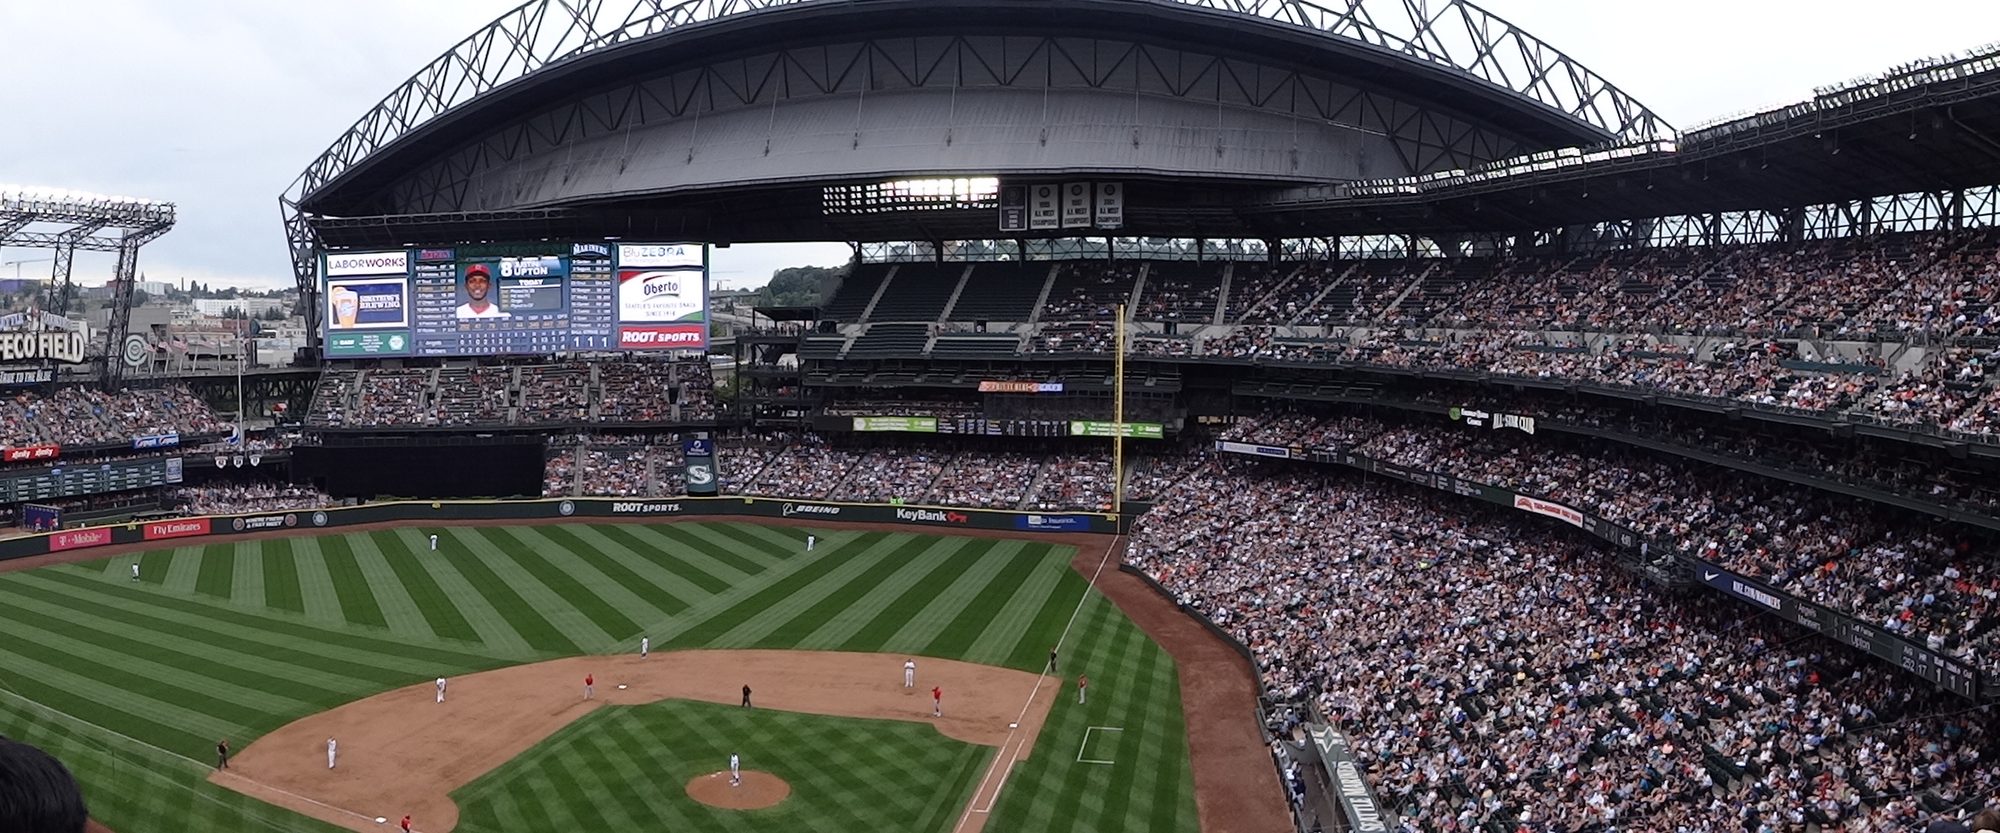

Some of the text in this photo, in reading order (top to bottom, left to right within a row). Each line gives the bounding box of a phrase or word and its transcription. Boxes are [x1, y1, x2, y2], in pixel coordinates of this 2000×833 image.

[573, 243, 608, 256] MARINERS
[501, 261, 513, 277] 8
[514, 266, 548, 276] UPTON
[643, 281, 678, 295] Oberto
[574, 336, 607, 348] 1 1 1
[621, 331, 700, 343] ROOT SPORTS
[38, 331, 85, 363] FIELD
[36, 368, 52, 382] BLUE
[1519, 416, 1535, 435] CLUB
[613, 502, 680, 512] ROOT SPORTS
[796, 505, 841, 515] BOEING
[896, 508, 947, 522] KeyBank
[153, 522, 201, 535] Fly Emirates
[1851, 634, 1871, 651] Upton
[1918, 664, 1927, 676] 17
